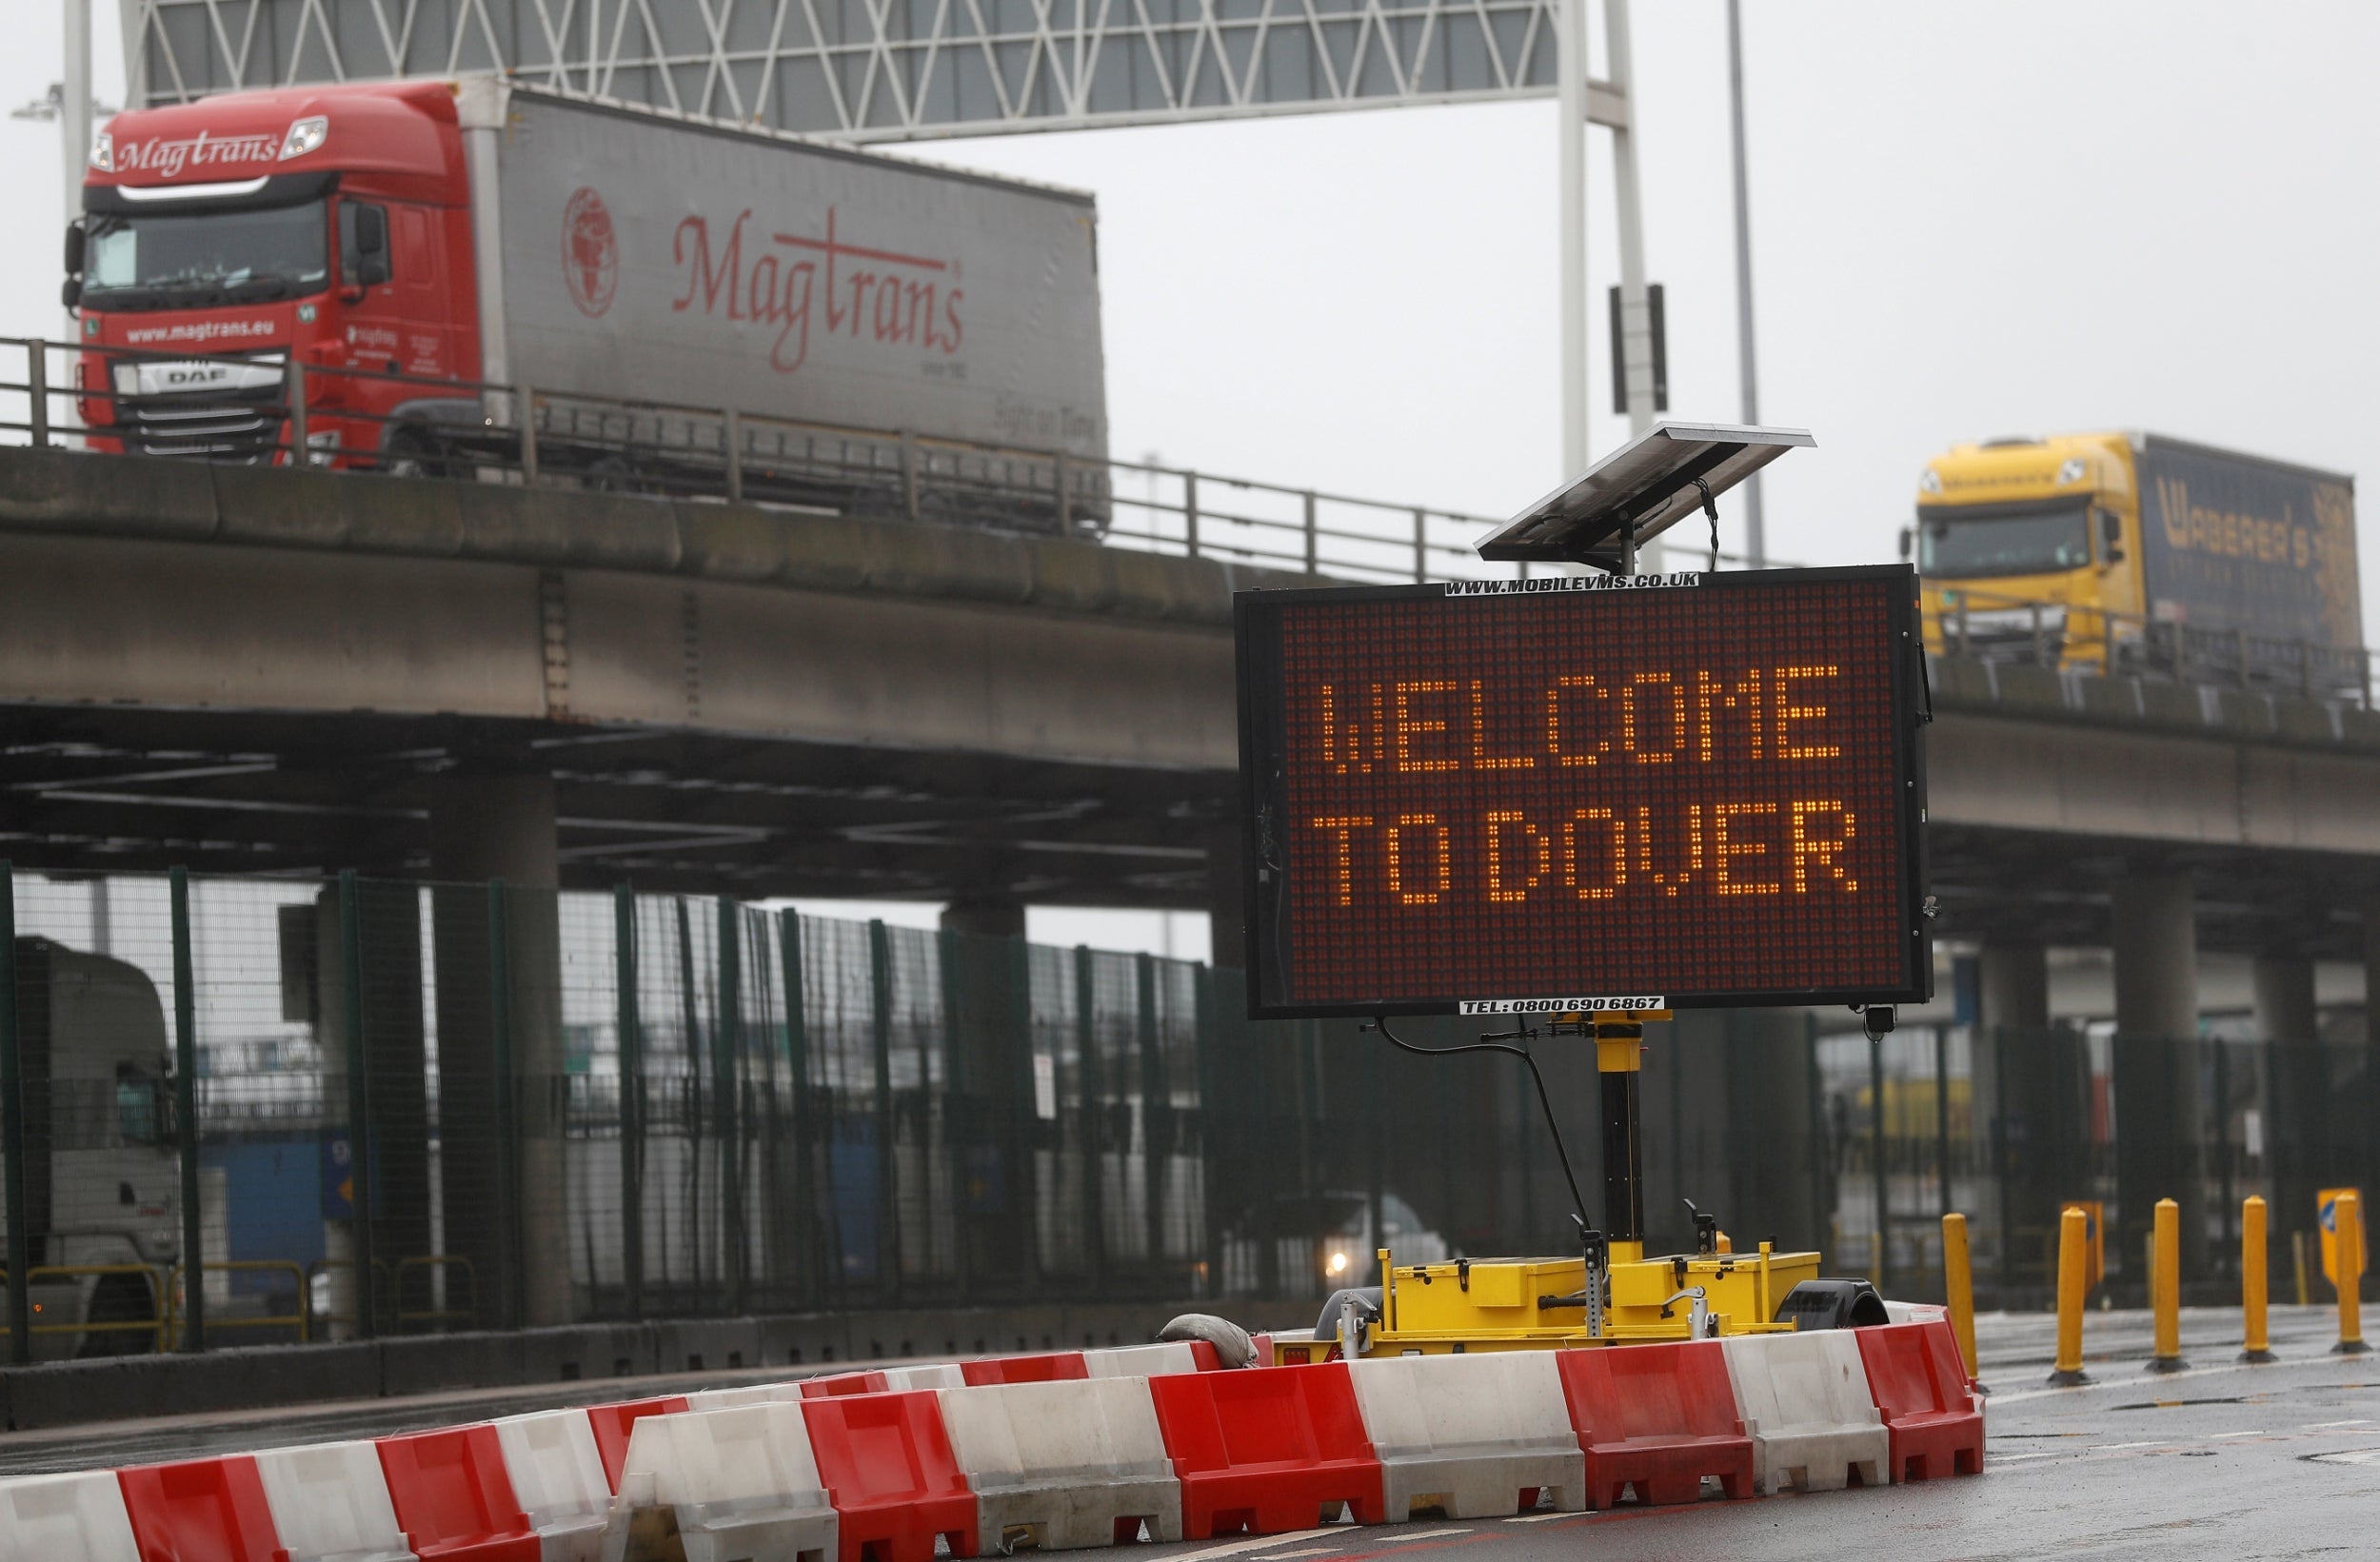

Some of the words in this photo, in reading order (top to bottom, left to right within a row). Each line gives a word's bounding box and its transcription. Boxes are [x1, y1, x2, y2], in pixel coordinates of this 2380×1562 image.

[116, 129, 279, 178] Magtrans
[672, 205, 964, 373] Magtrans
[127, 320, 275, 343] www.magtrans.eu
[169, 368, 227, 385] DAF
[1446, 572, 1698, 595] WWW.MOBILEVMS.CO.UK
[1322, 663, 1840, 774] WELCOME
[1313, 813, 1451, 907] TO
[1487, 800, 1858, 902] DOVER
[1464, 1001, 1508, 1013] TEL:
[1512, 1000, 1564, 1012] 0800
[1567, 998, 1606, 1011] 690
[1609, 998, 1661, 1010] 6867
